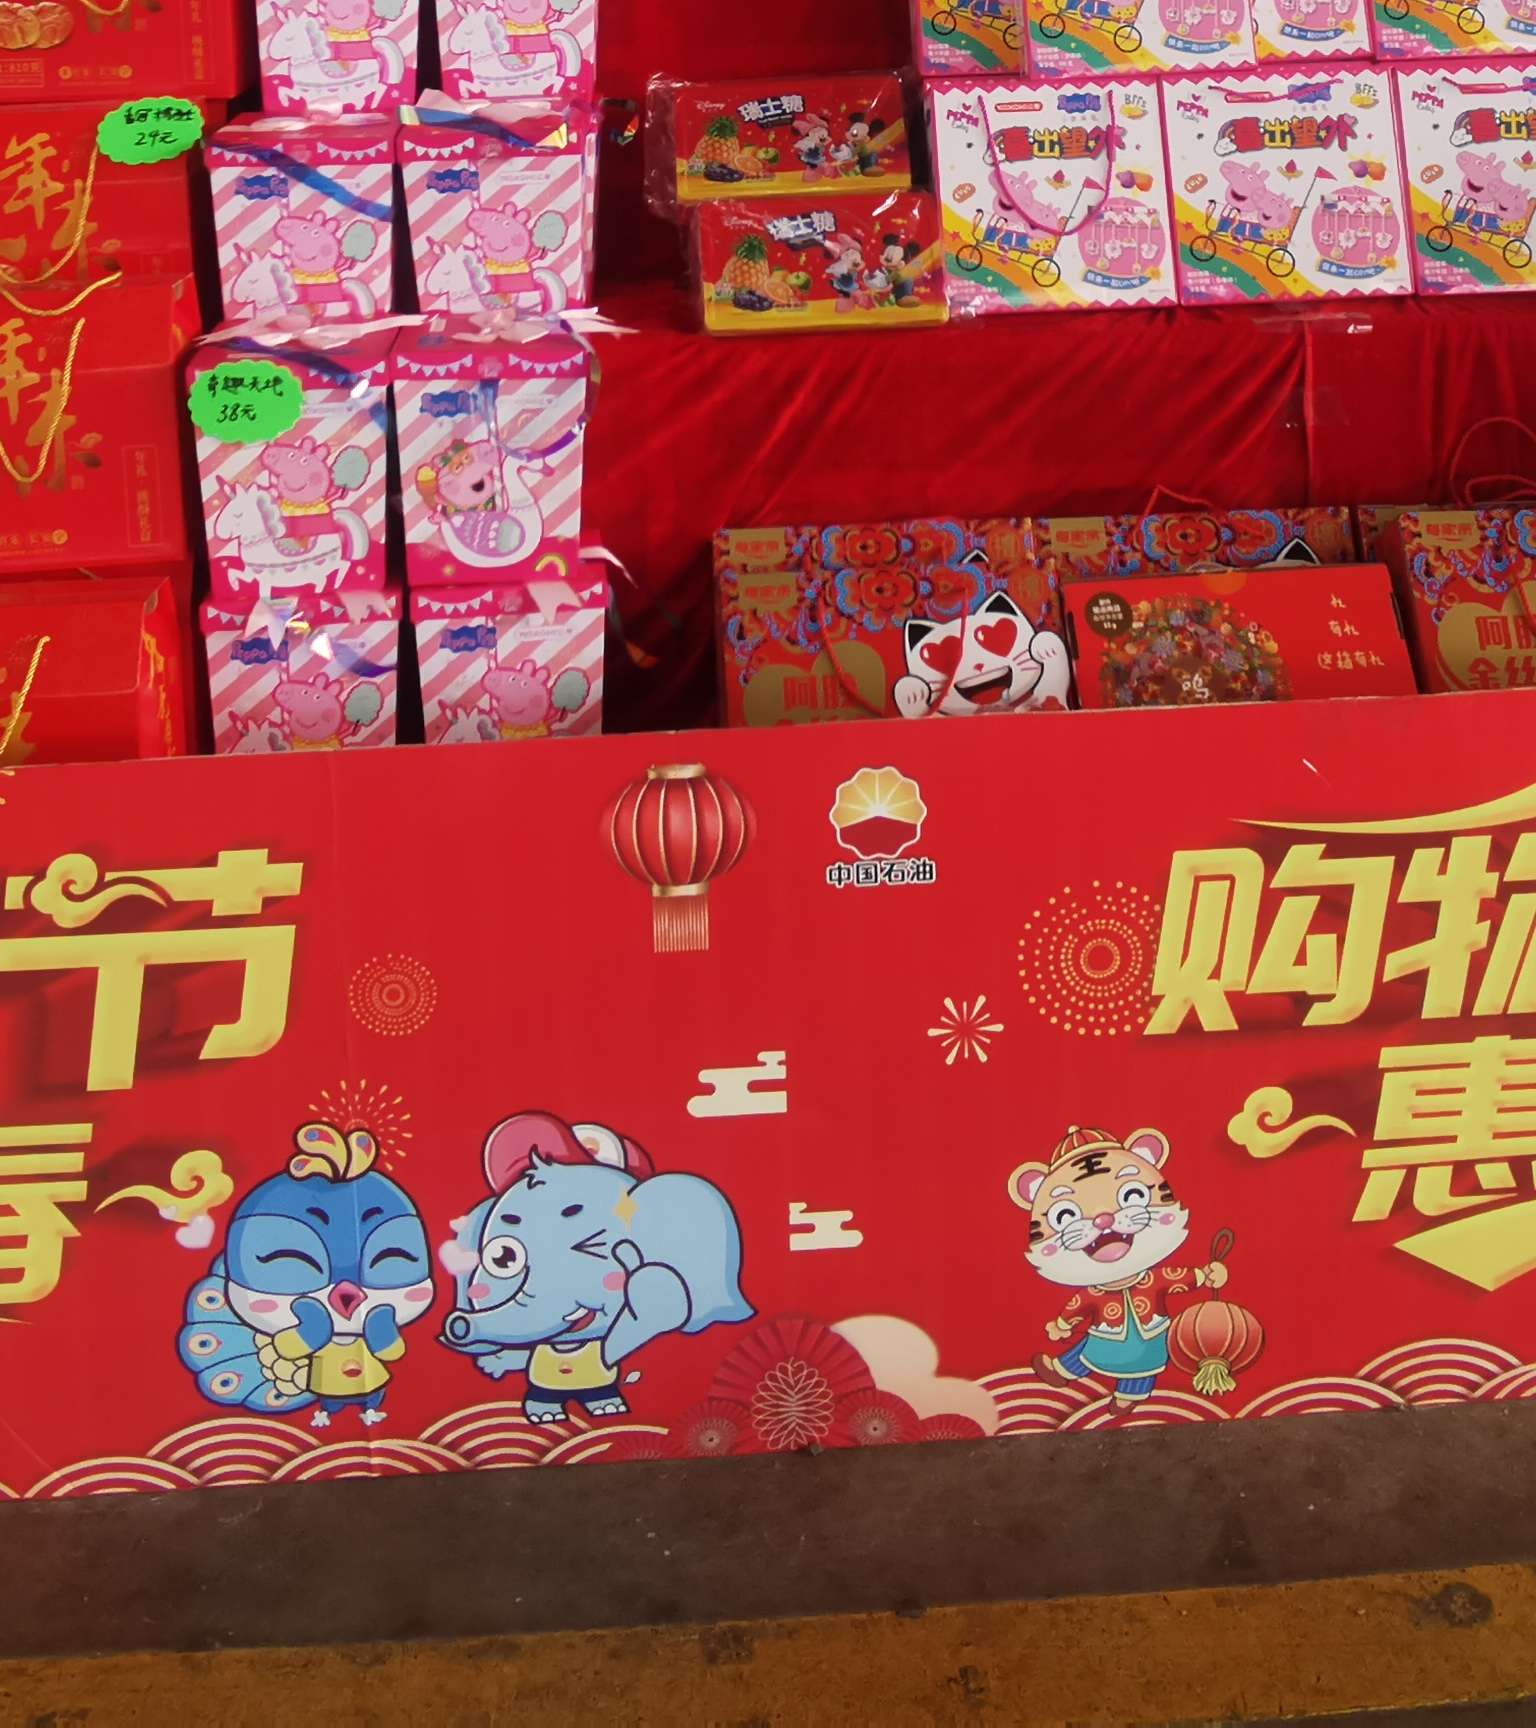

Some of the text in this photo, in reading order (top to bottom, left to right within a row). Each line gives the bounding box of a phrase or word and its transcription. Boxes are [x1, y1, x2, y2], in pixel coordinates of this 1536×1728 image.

[738, 95, 805, 122] 瑞士糖
[216, 402, 257, 424] 38元
[826, 857, 937, 889] 中国石油
